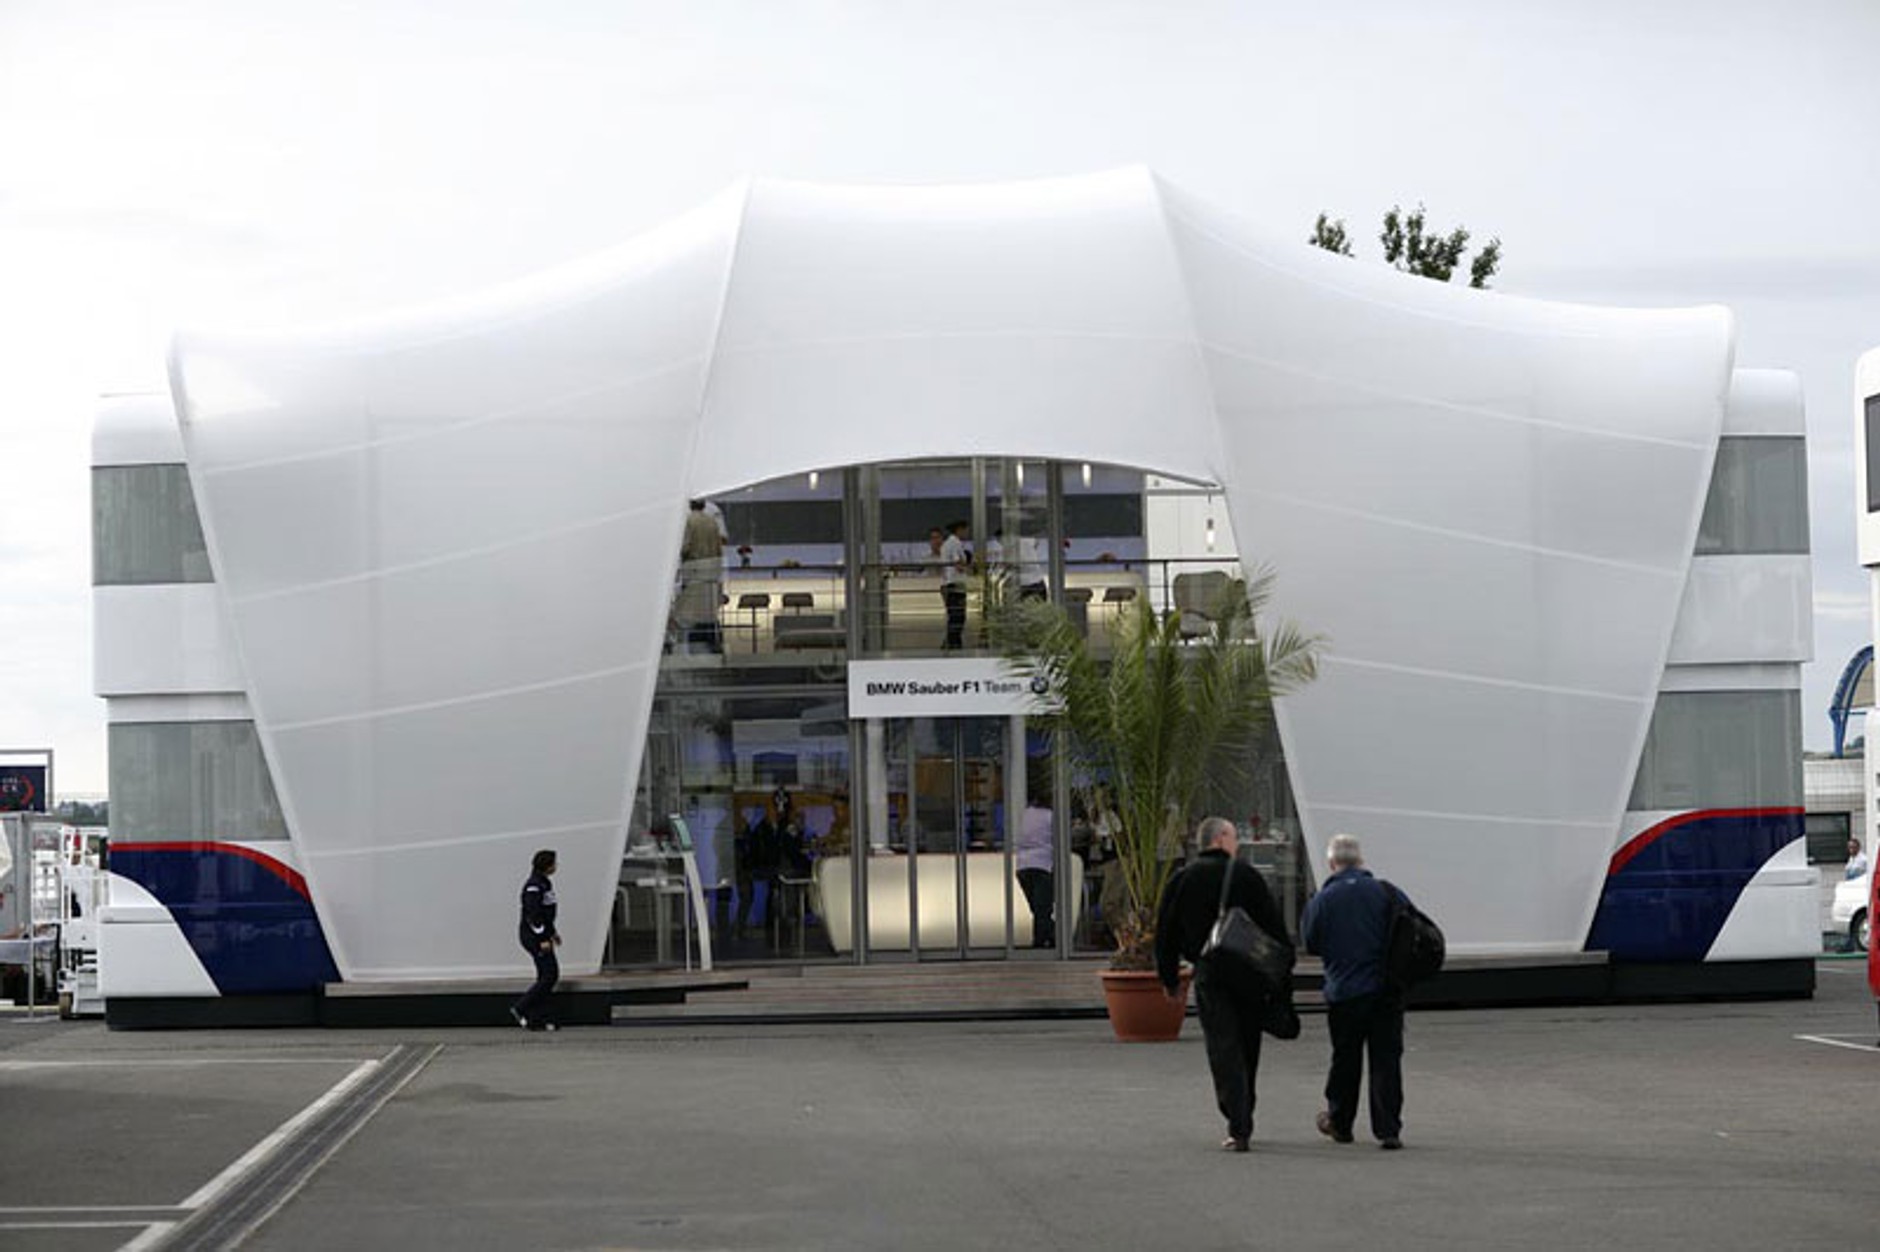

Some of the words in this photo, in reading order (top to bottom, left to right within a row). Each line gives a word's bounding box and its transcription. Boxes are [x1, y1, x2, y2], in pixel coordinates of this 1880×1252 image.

[866, 682, 904, 696] BMW
[907, 681, 960, 695] Sauber
[962, 680, 980, 693] F1
[983, 681, 1021, 694] Team
